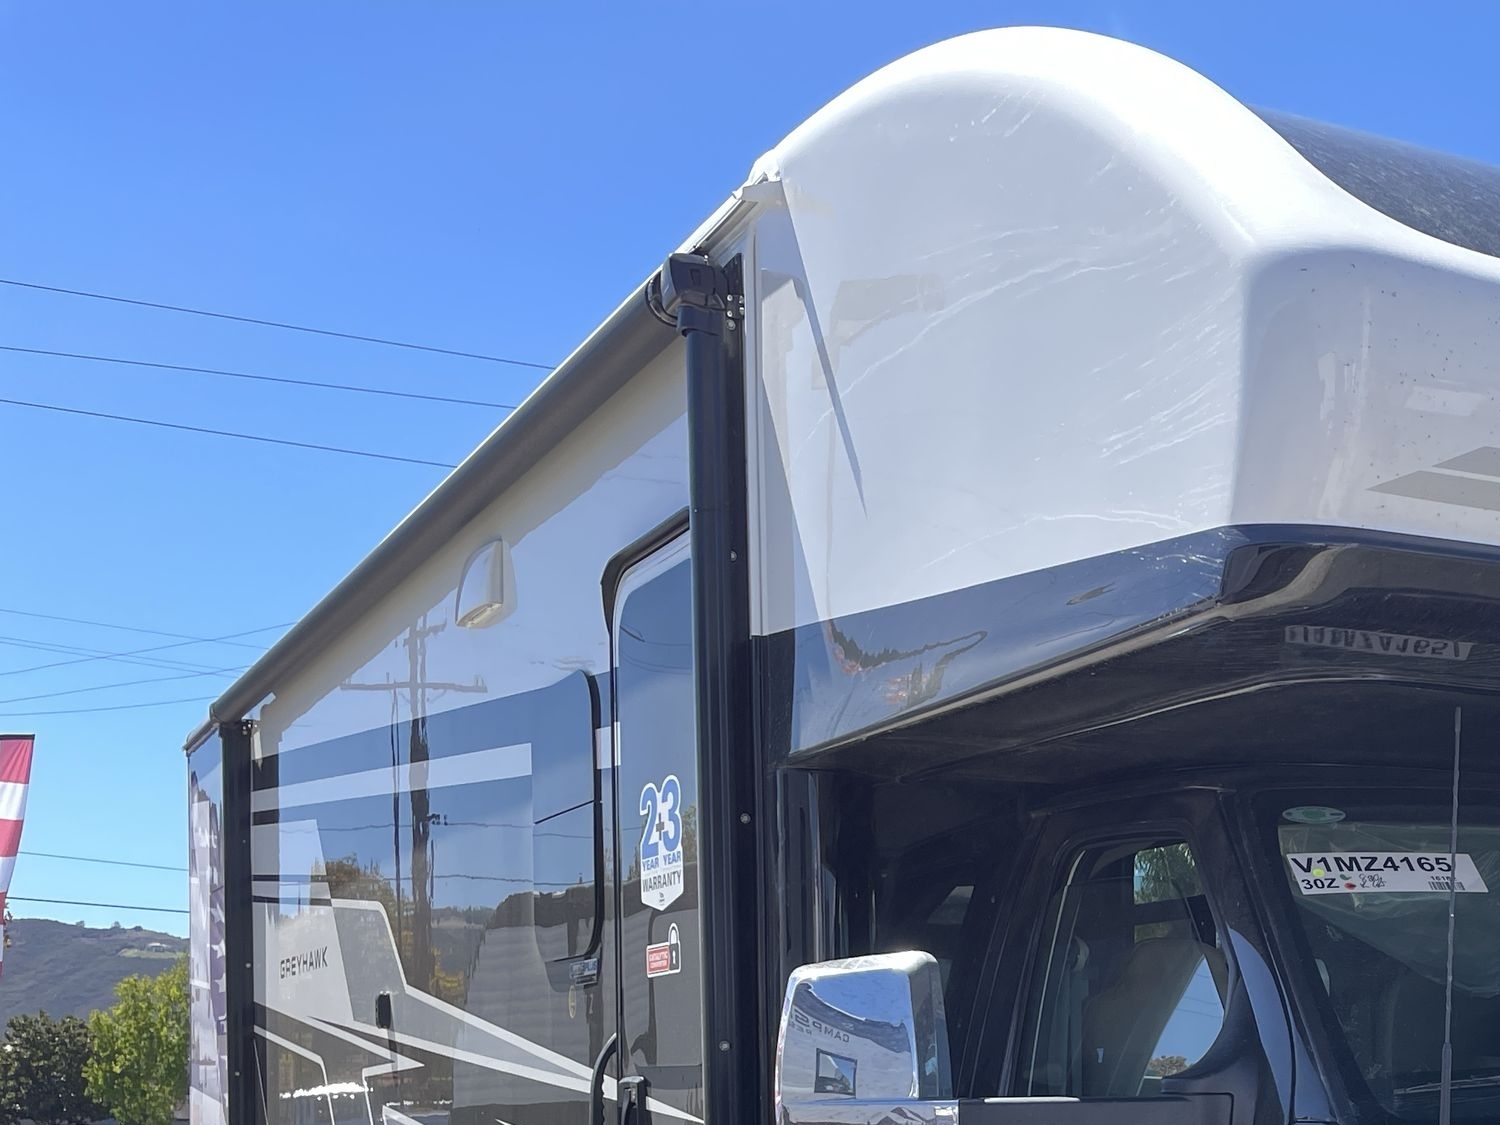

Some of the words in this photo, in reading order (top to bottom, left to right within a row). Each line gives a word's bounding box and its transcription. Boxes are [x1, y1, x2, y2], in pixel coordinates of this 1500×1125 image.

[642, 858, 659, 872] YEAR
[663, 851, 681, 865] YEAR
[1291, 857, 1452, 873] V1MZ4165
[642, 870, 681, 893] WARRANTY
[1301, 878, 1340, 889] 30Z
[280, 946, 328, 979] GREYHAWK
